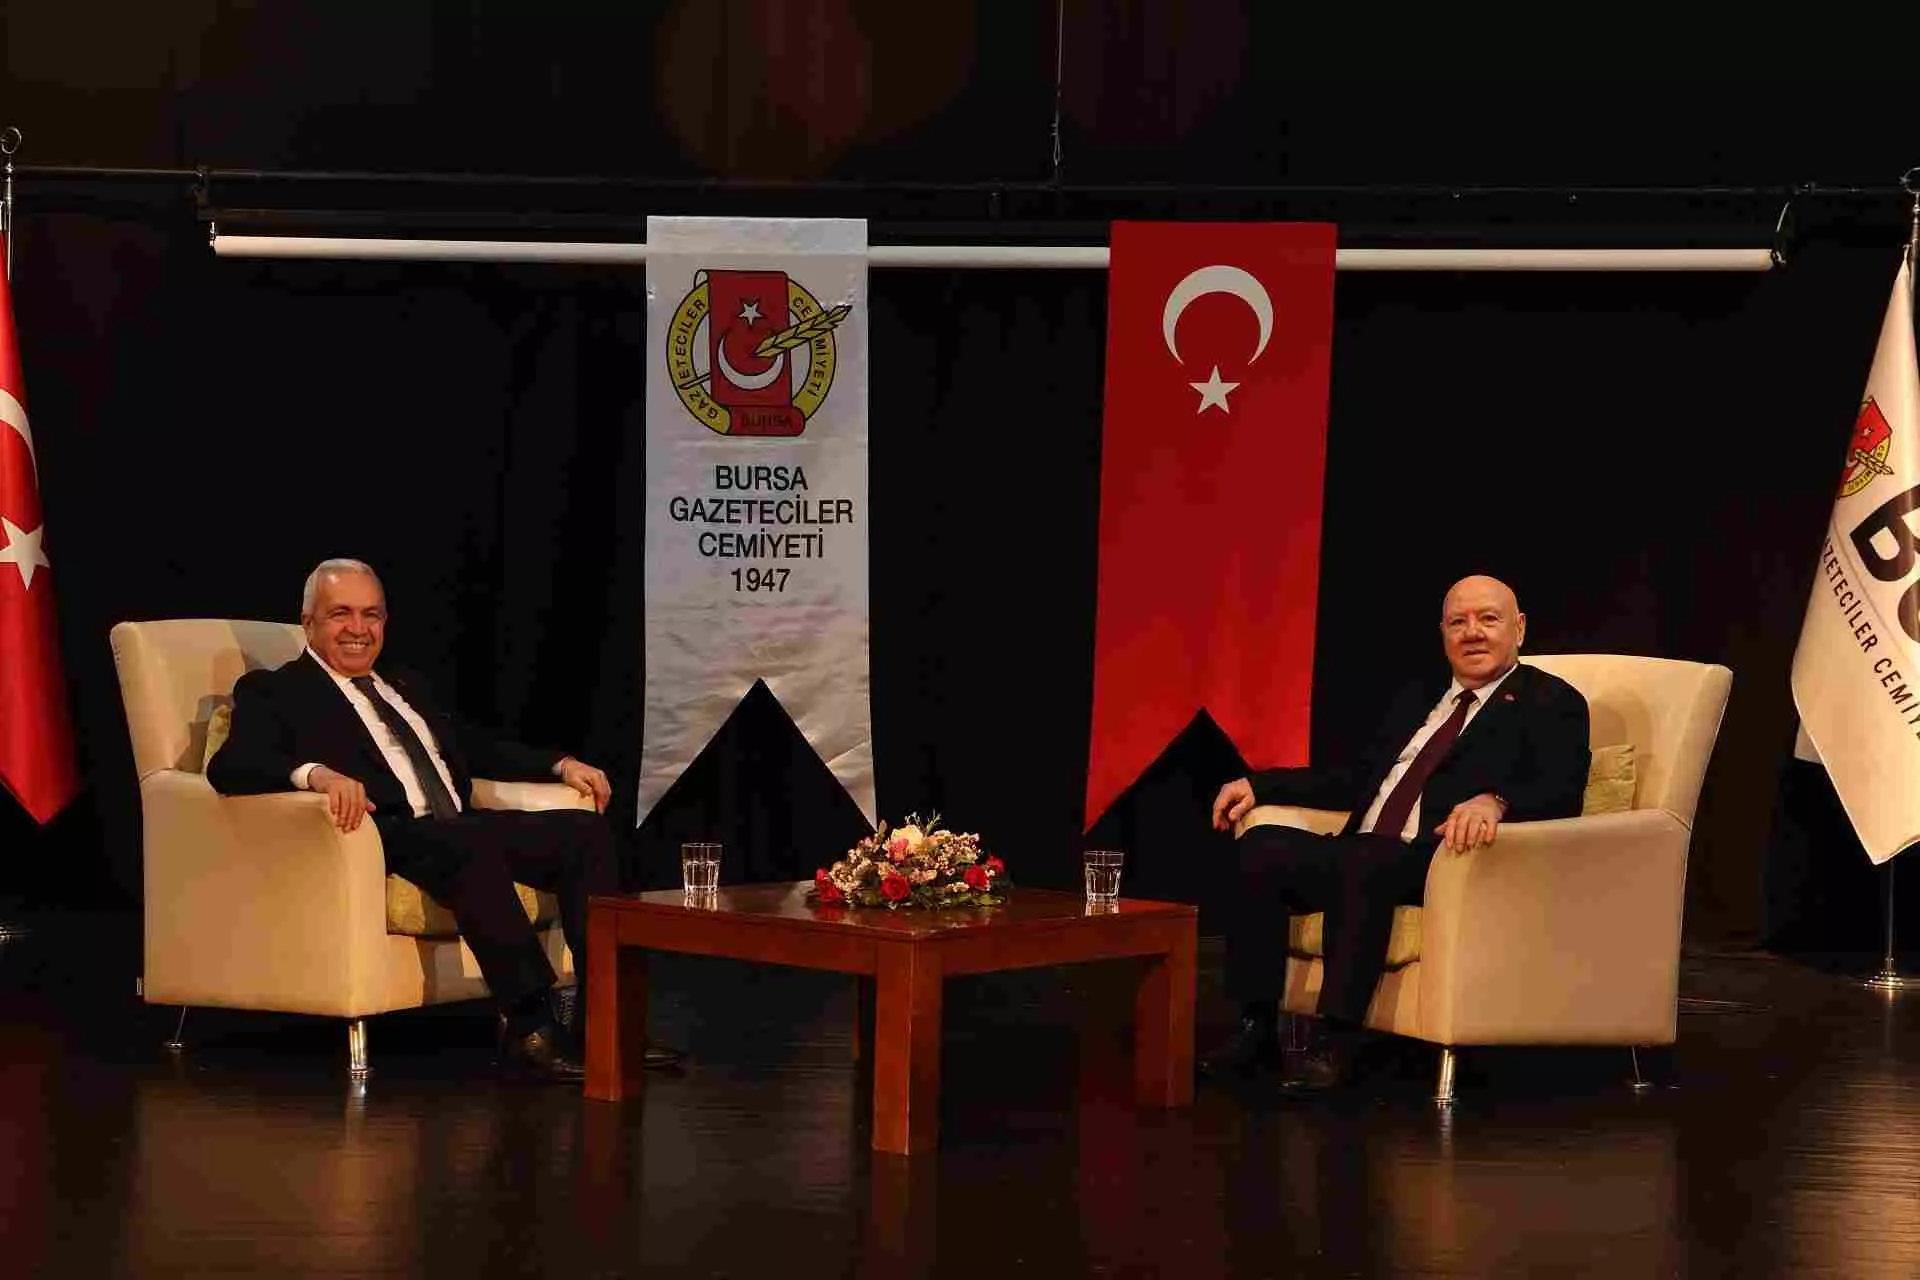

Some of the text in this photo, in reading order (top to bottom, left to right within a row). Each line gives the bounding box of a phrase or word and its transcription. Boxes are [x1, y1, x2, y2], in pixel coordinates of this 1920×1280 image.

[715, 465, 808, 491] BURSA
[670, 494, 853, 524] GAZETECİLER
[699, 528, 823, 558] CEMİYETİ
[731, 567, 791, 592] 1947
